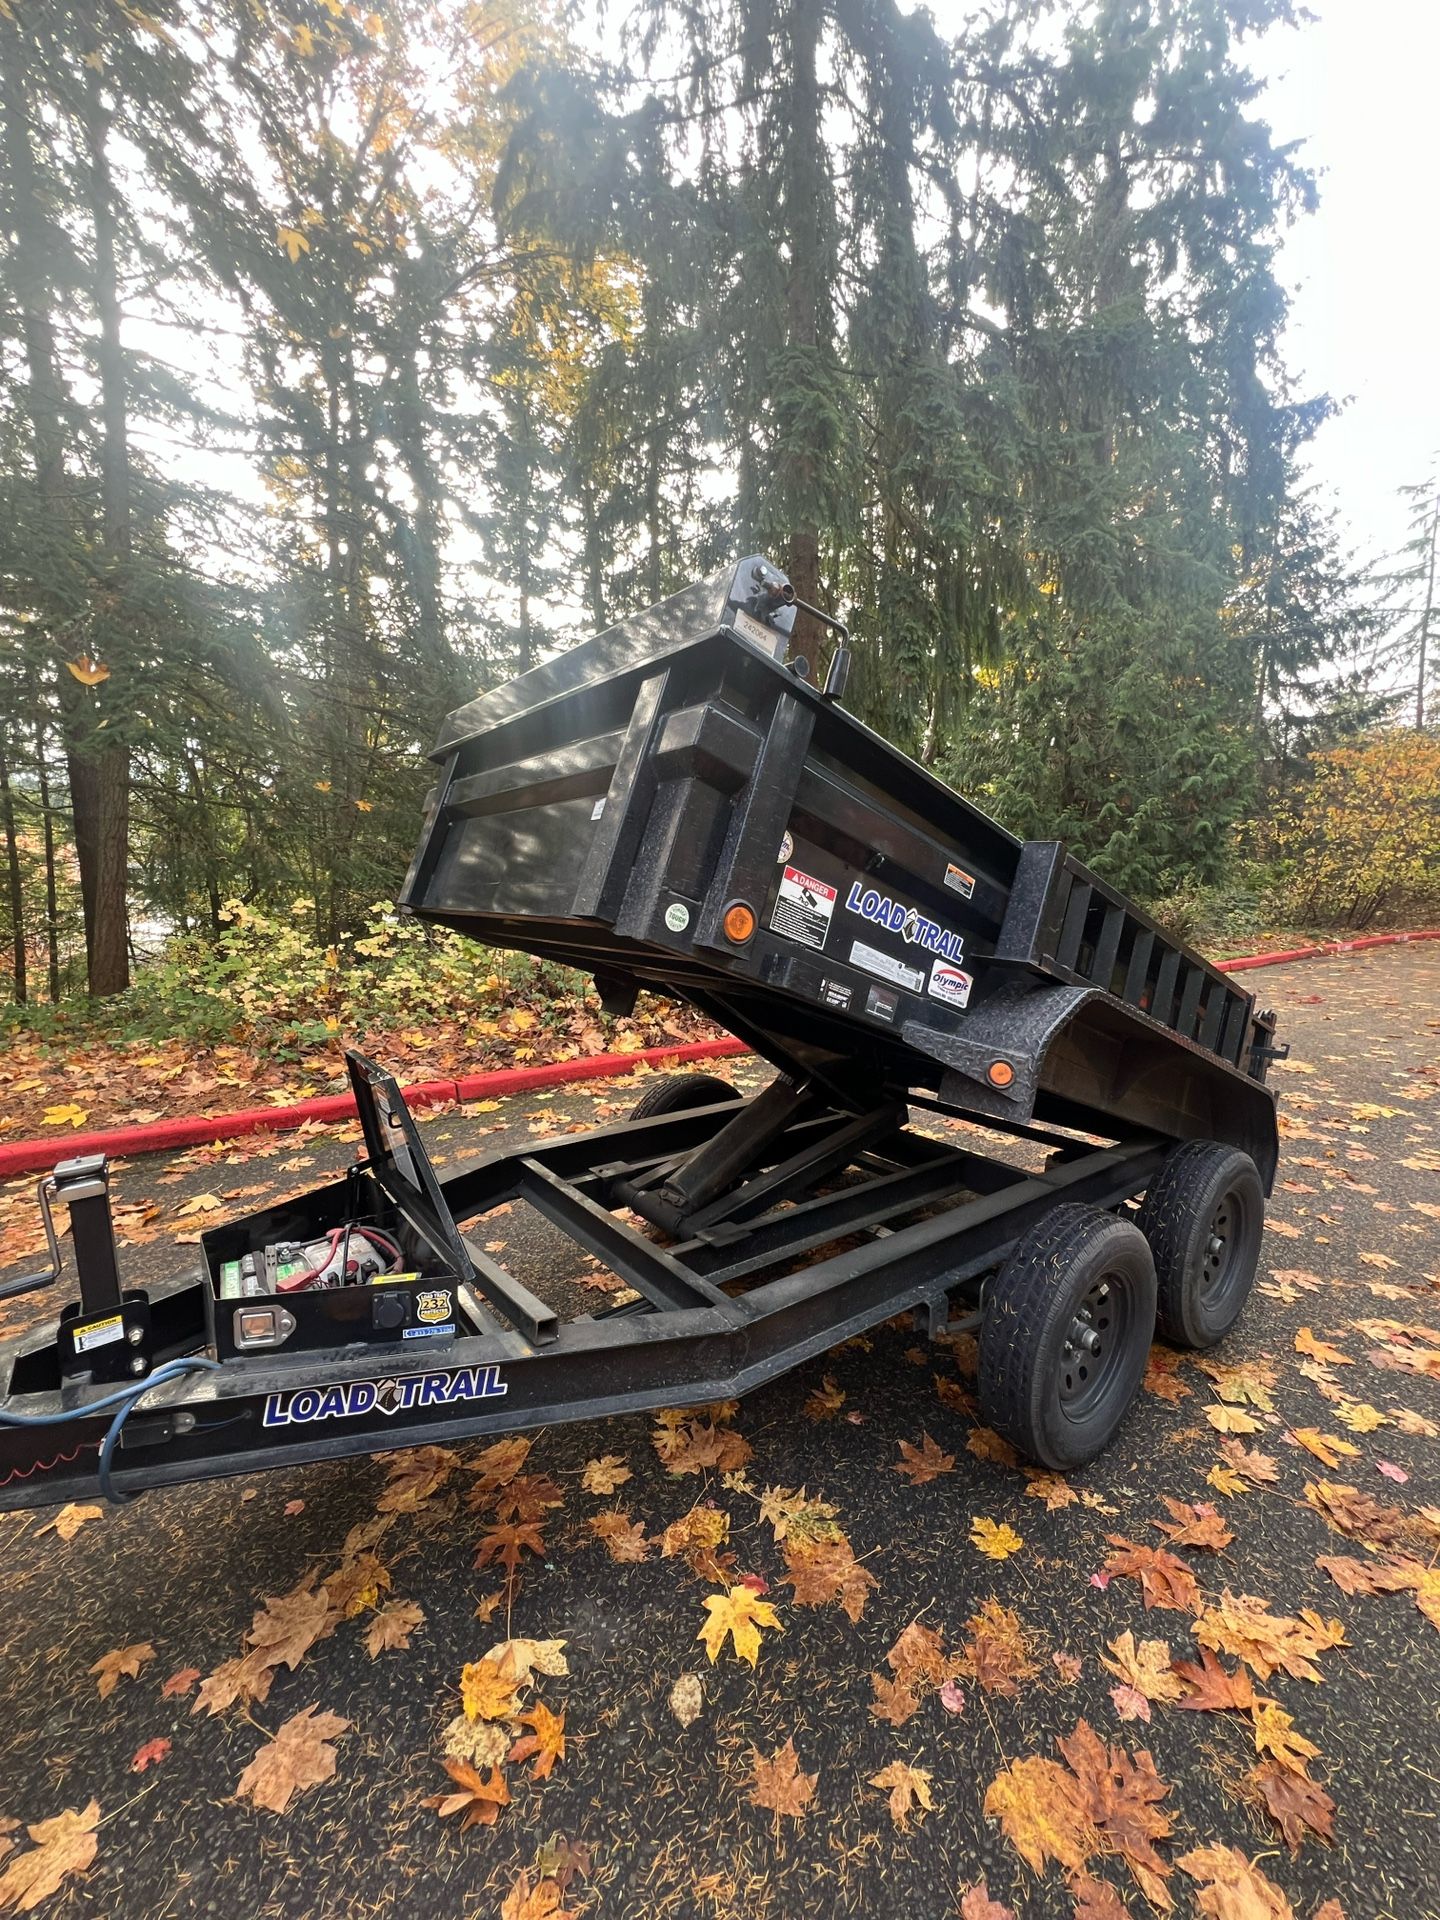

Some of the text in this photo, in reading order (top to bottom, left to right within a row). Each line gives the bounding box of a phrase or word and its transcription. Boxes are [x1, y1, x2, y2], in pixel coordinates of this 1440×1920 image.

[799, 874, 829, 897] DANGER
[845, 881, 907, 933] LOAD
[913, 915, 963, 965] TRAIL
[933, 974, 969, 991] Olympic
[423, 1299, 446, 1309] 232
[88, 1319, 117, 1331] CAUTION
[263, 1366, 508, 1427] LOAD TRAIL
